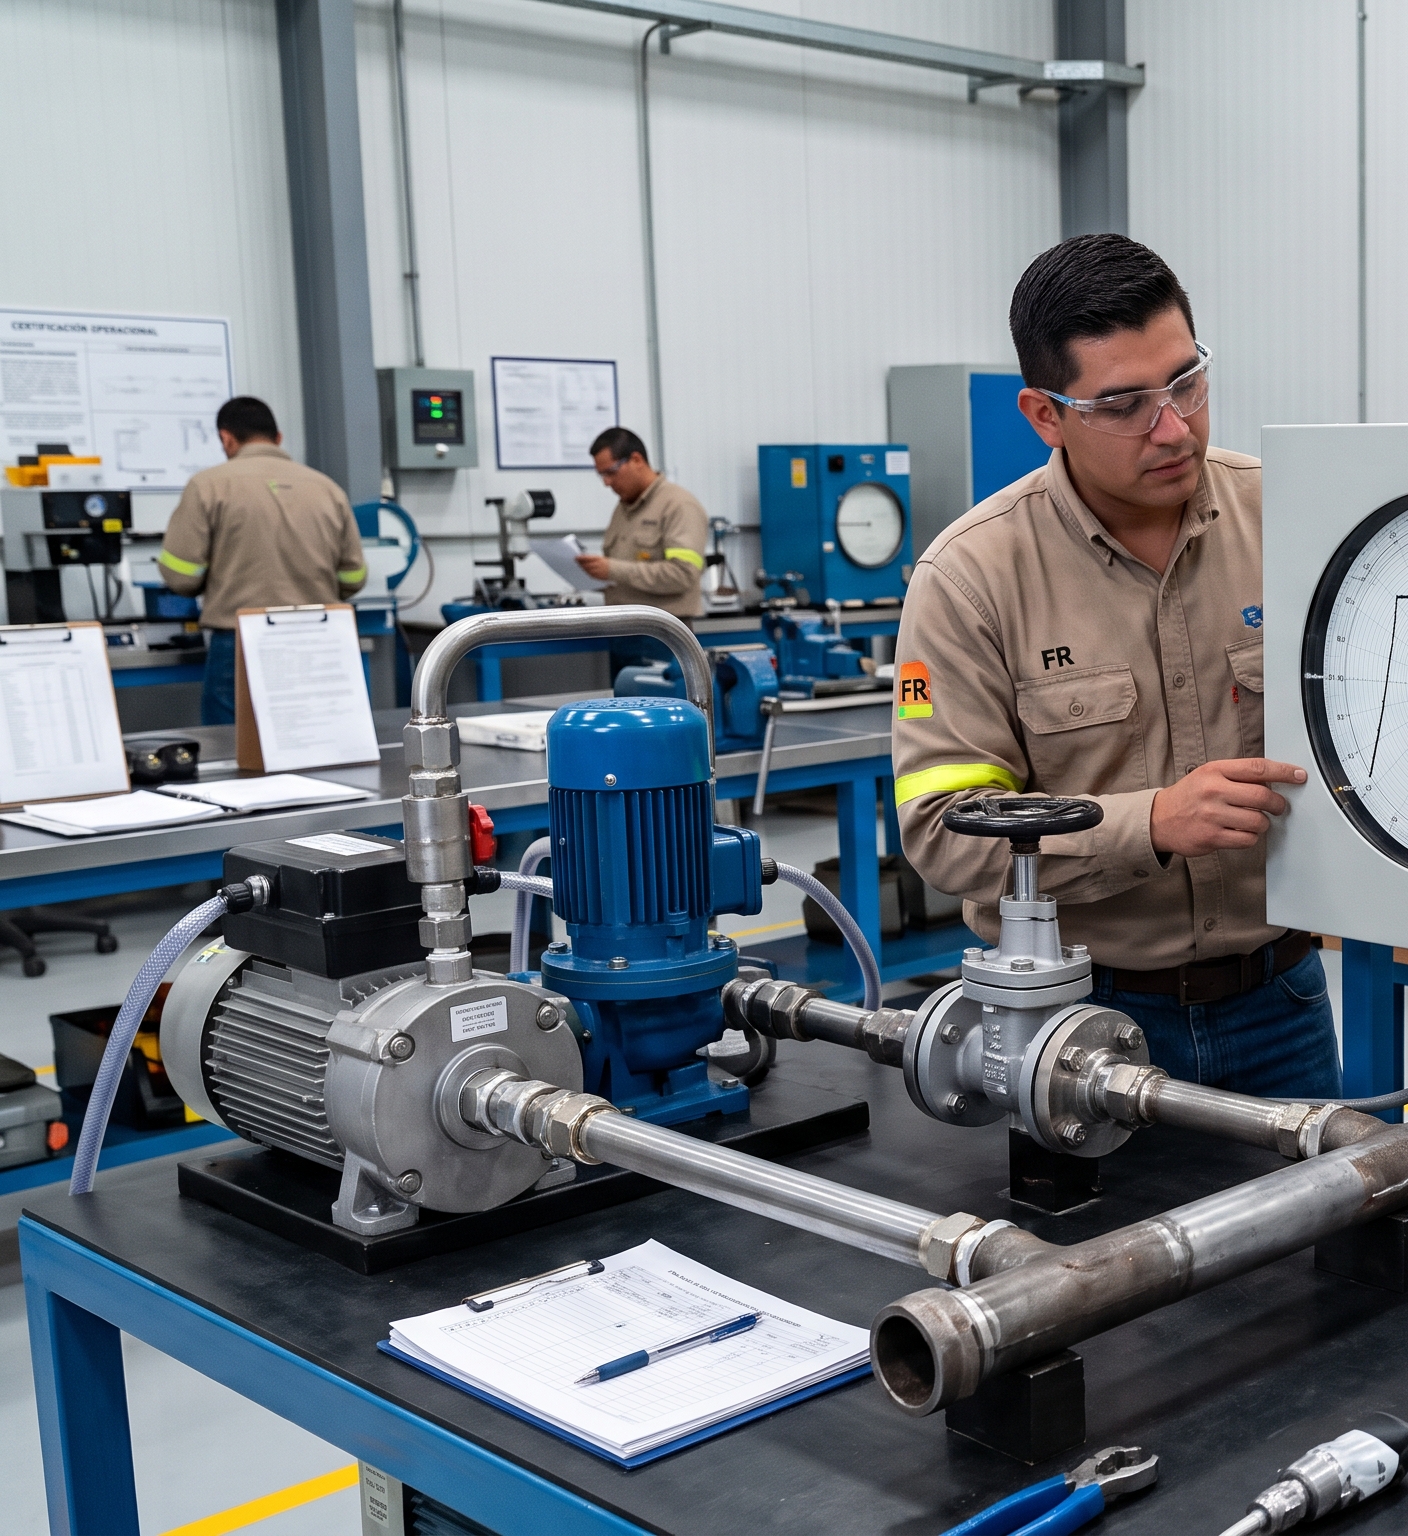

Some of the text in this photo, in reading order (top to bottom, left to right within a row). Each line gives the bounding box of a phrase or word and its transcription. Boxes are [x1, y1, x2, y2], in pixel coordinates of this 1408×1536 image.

[11, 321, 158, 336] CERTIFICACIÓN OPERACIONAL
[1041, 646, 1074, 670] FR
[901, 678, 928, 702] FR
